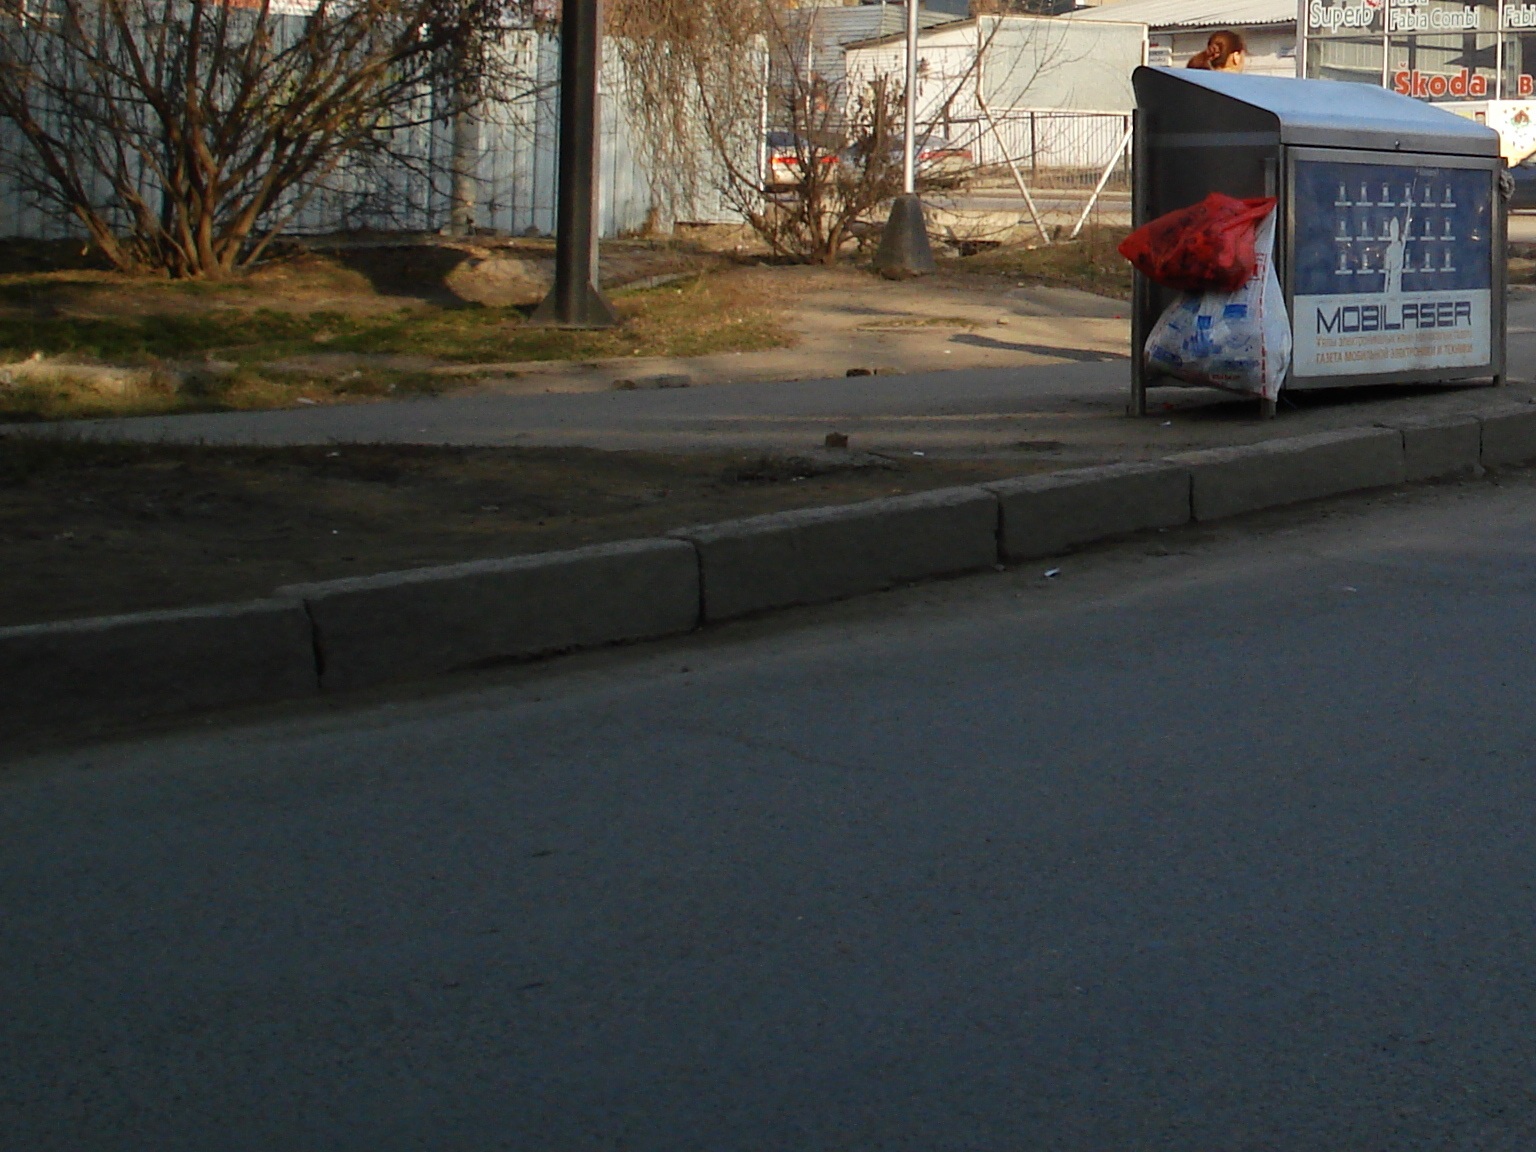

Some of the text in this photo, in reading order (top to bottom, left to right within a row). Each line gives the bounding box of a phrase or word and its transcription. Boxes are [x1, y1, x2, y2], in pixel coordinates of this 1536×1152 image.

[1309, 0, 1374, 34] Superb
[1390, 6, 1480, 30] Fabia Combi
[1316, 301, 1471, 334] MOBILASER
